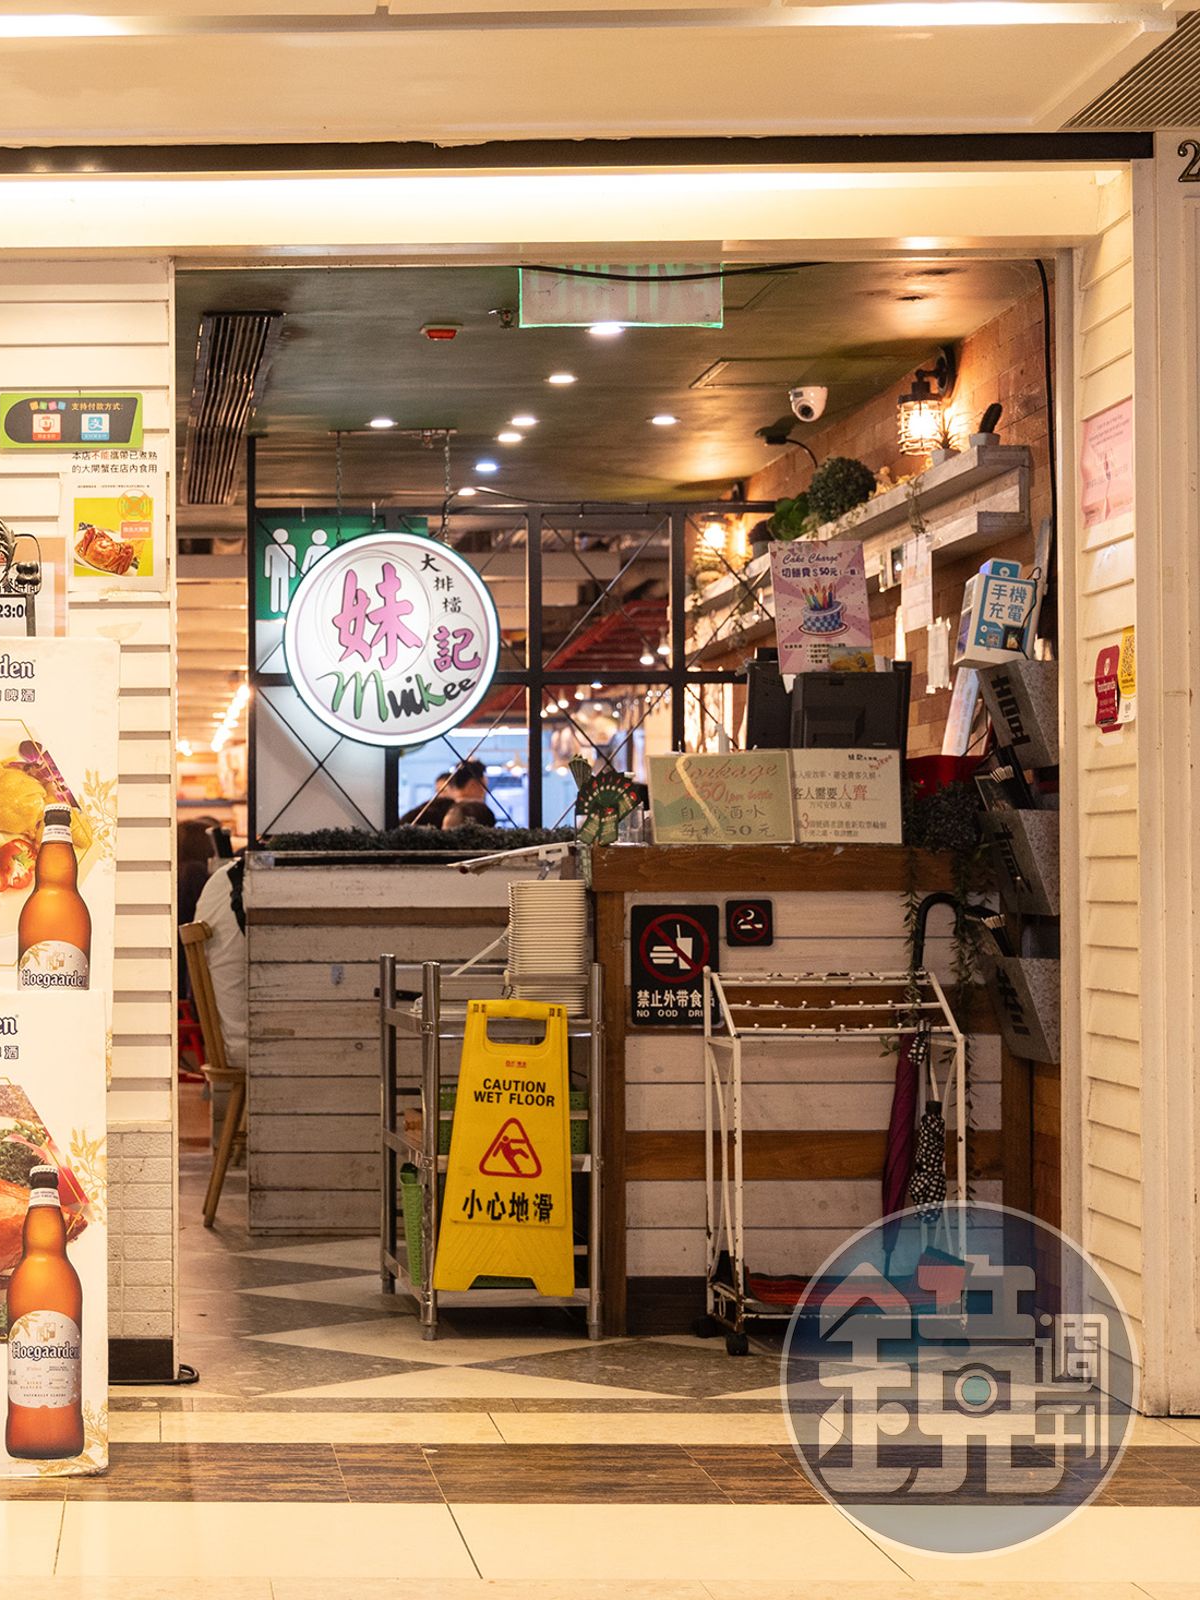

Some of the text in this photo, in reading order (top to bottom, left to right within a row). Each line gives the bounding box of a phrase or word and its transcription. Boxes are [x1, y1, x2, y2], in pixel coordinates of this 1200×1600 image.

[420, 553, 462, 614] 大排檔
[991, 583, 1027, 604] 手機
[989, 602, 1025, 623] 充電
[636, 1009, 650, 1018] NO
[657, 1009, 679, 1018] OOD
[482, 1078, 546, 1094] CAUTION
[473, 1091, 556, 1107] WET FLOOR
[462, 1188, 554, 1224] 小心地滑
